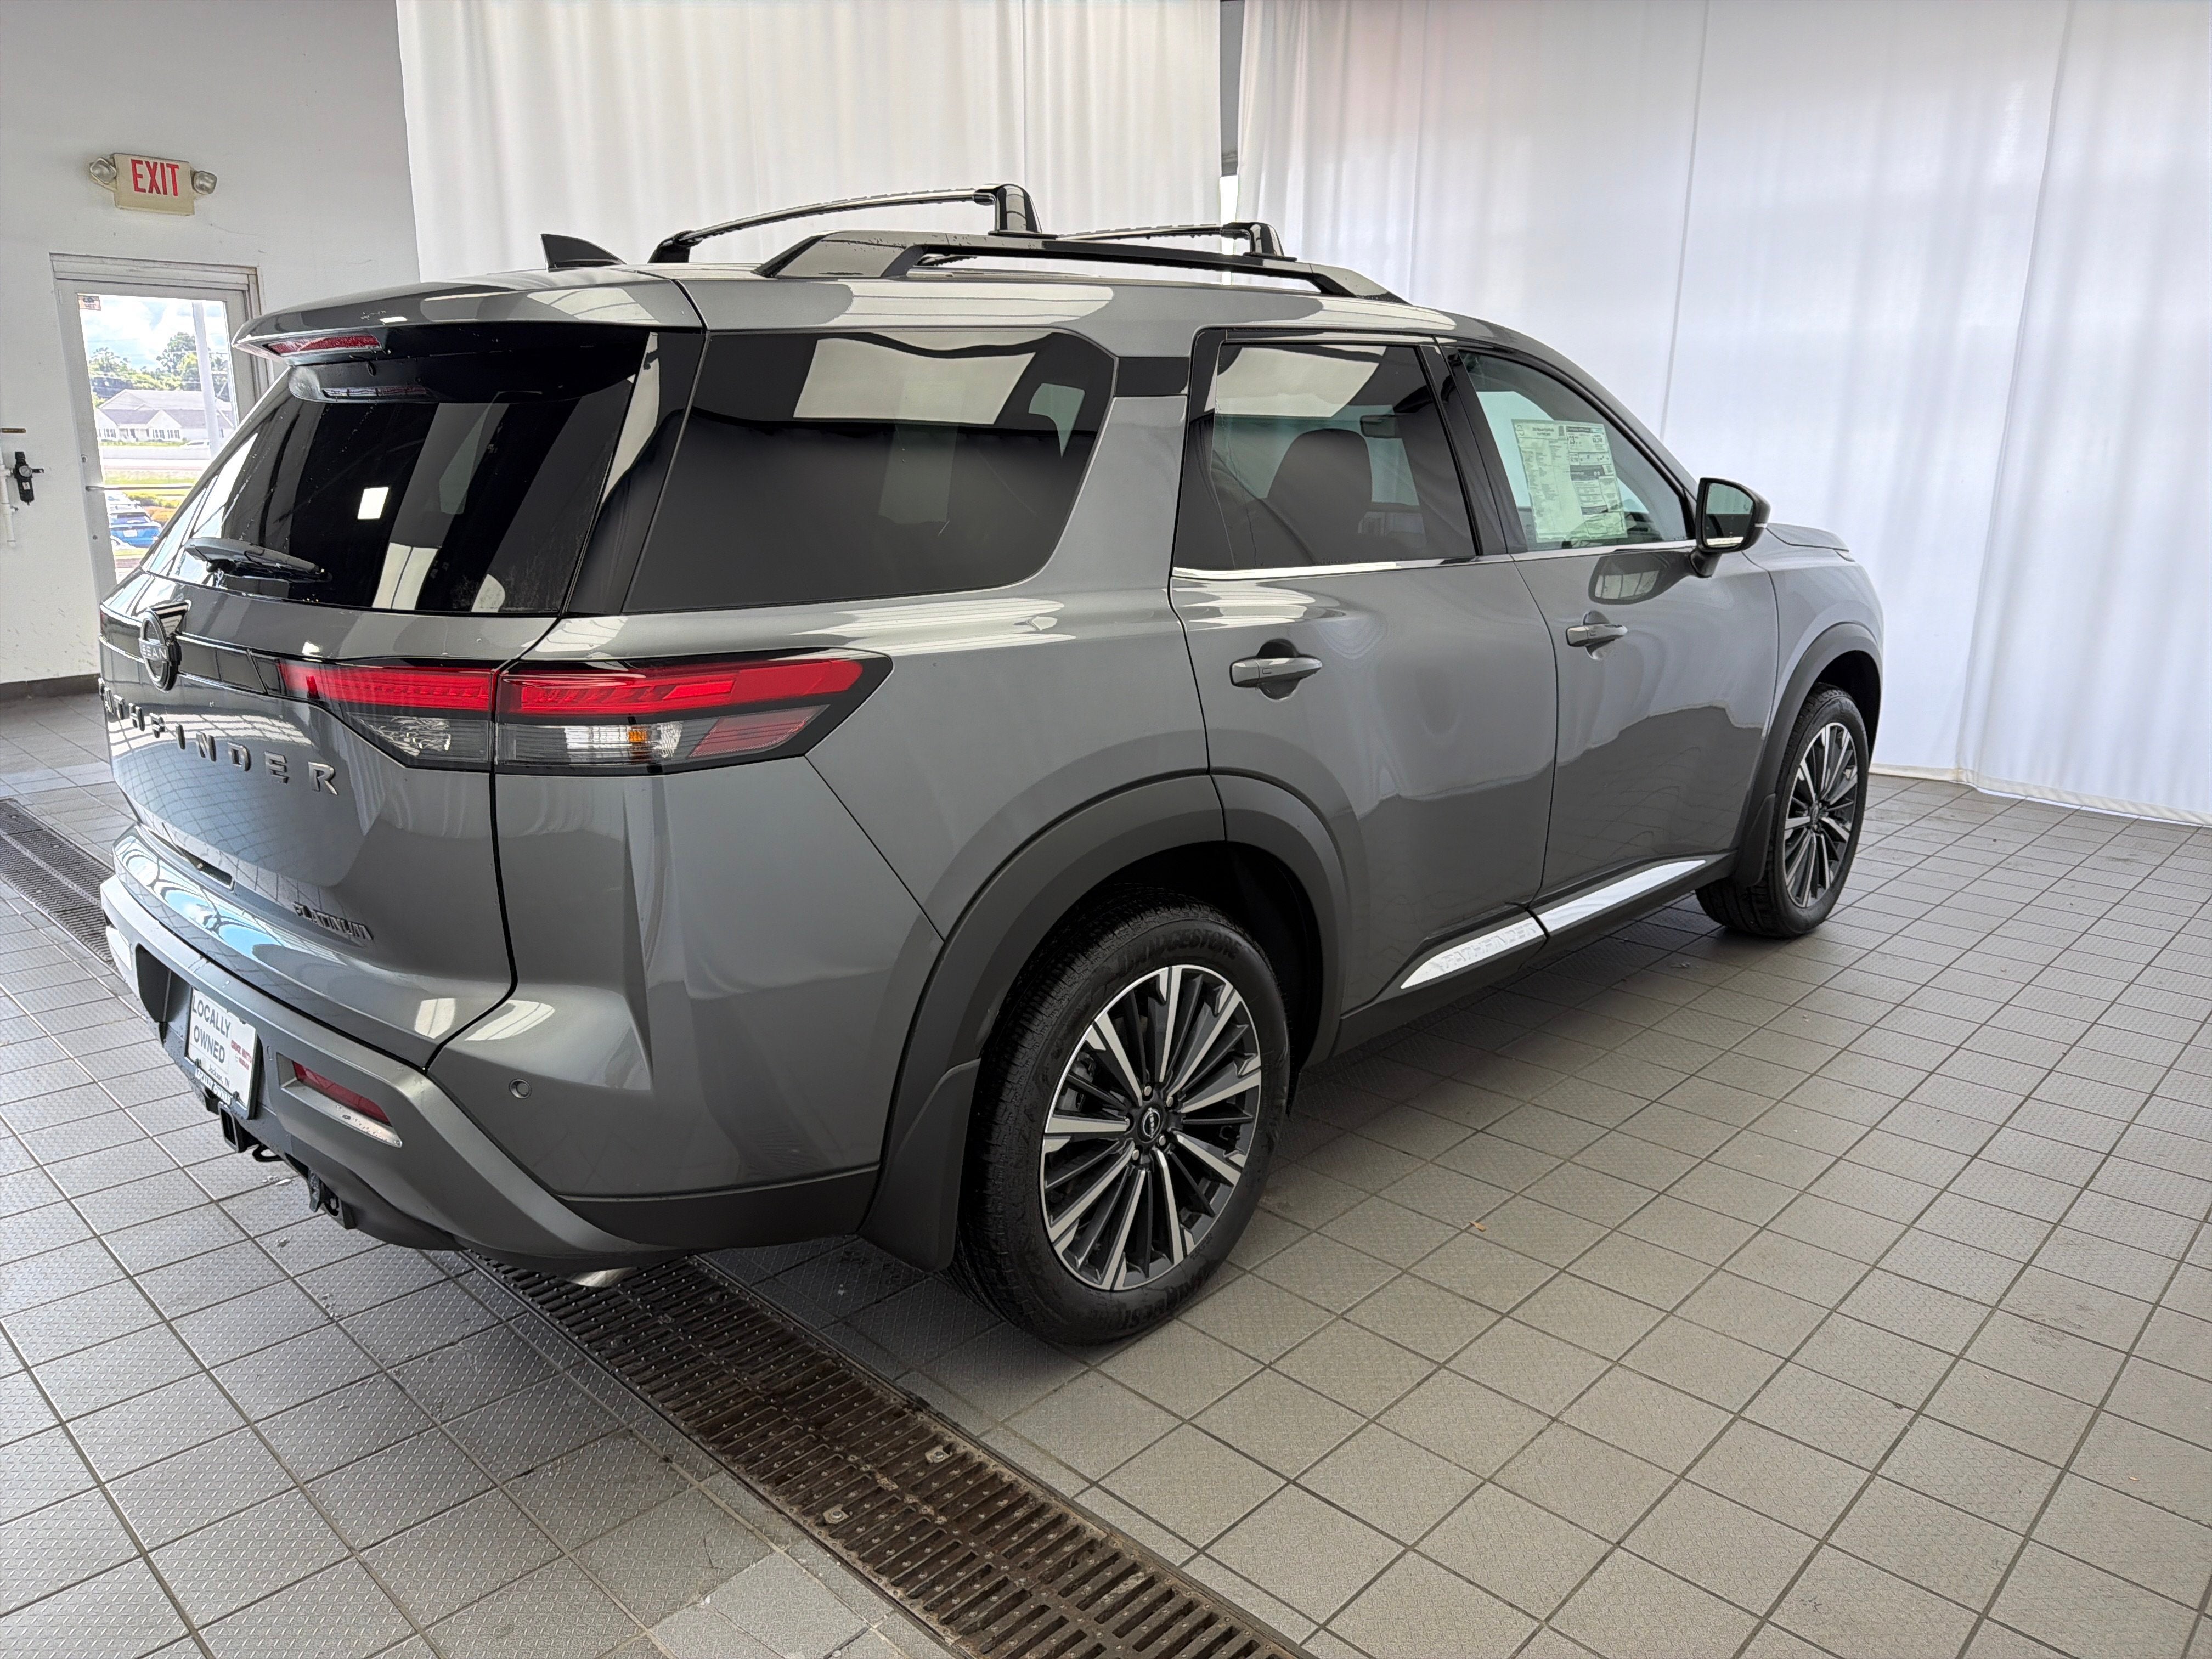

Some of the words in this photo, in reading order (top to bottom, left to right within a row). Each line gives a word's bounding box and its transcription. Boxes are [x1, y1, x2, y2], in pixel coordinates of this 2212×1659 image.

[131, 159, 179, 197] EXIT
[292, 901, 375, 940] PLATINUM
[1441, 922, 1537, 969] PATHFINDER
[193, 995, 231, 1039] LOCALLY
[194, 1025, 225, 1064] OWNED
[225, 1077, 230, 1088] TN
